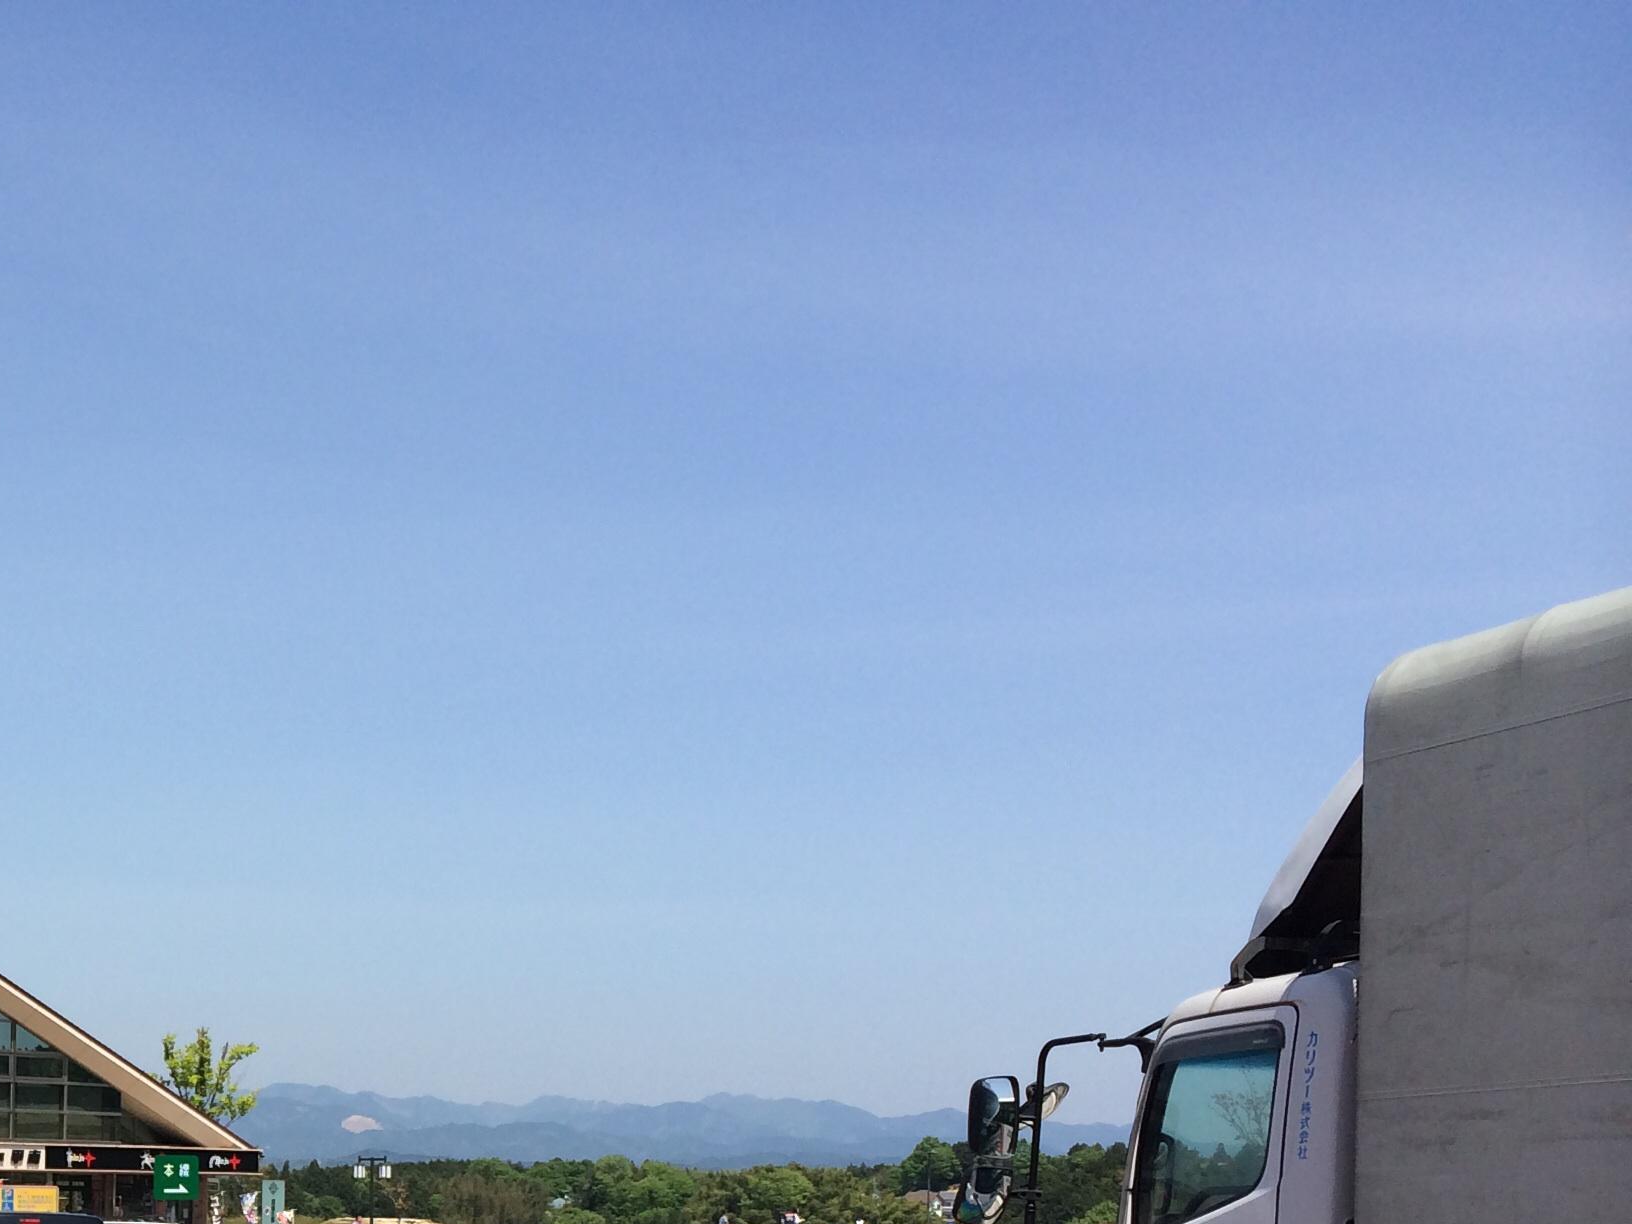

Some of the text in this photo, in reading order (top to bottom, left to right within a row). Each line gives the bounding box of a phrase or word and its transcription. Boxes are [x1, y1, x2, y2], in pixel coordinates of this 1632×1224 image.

[1297, 1031, 1318, 1160] カリツー株式会社
